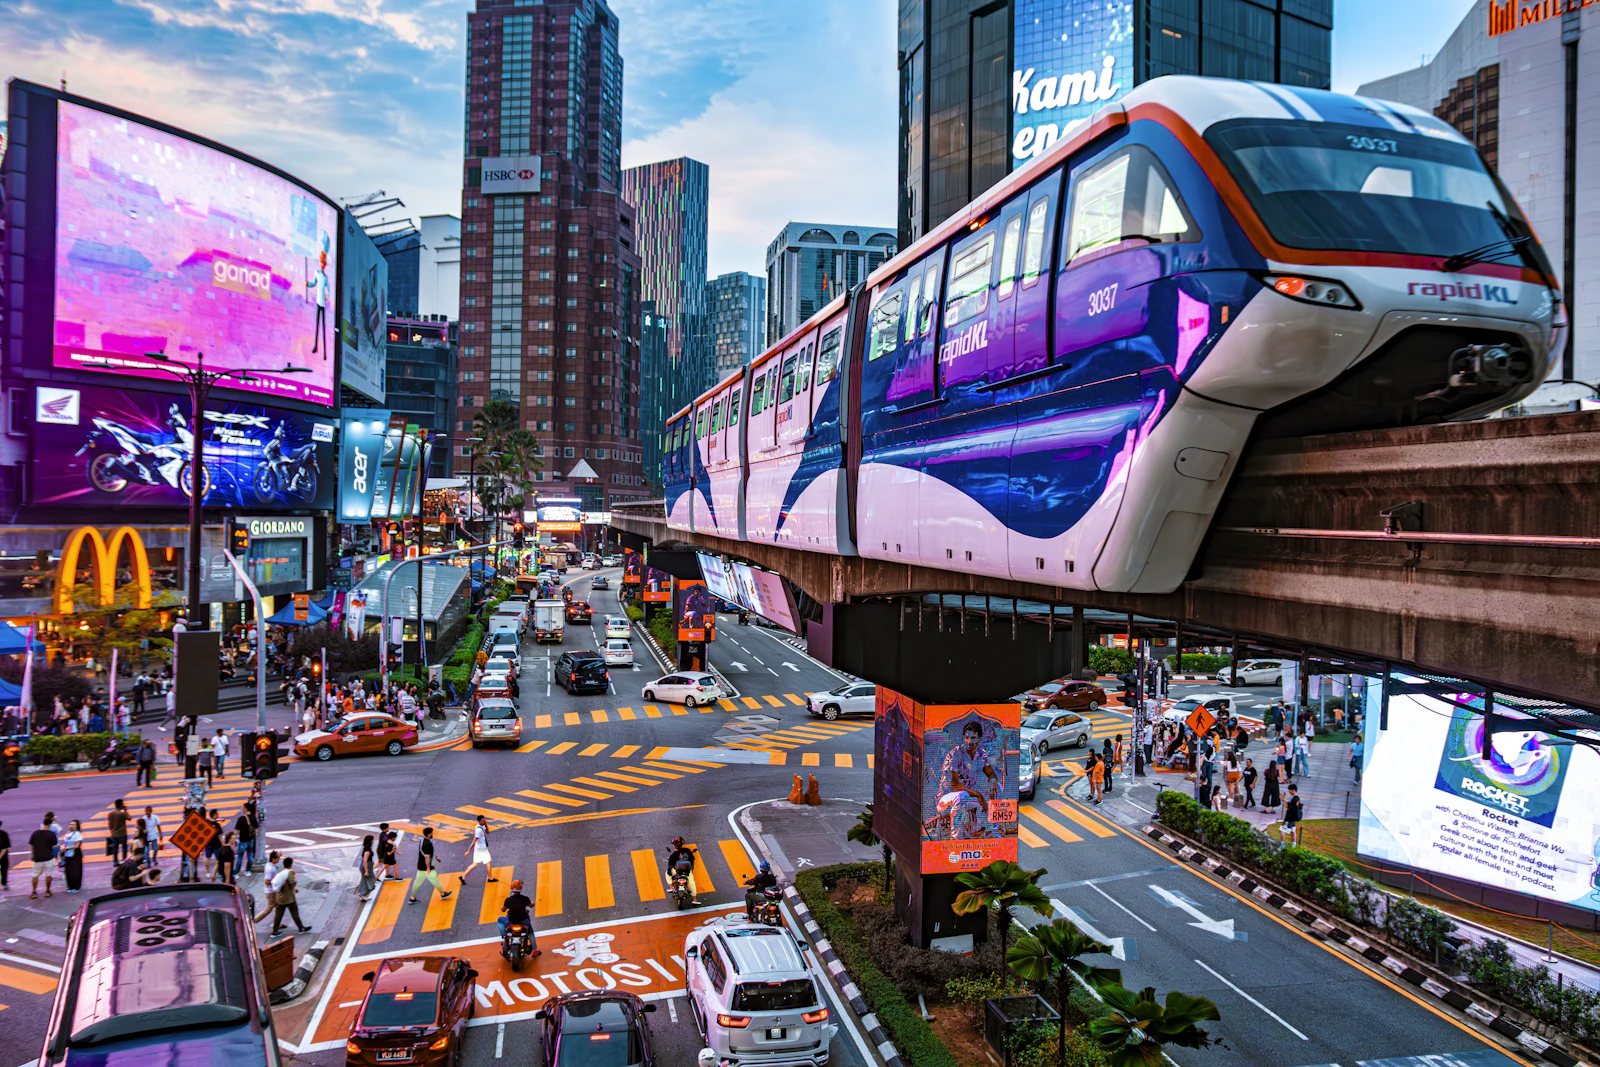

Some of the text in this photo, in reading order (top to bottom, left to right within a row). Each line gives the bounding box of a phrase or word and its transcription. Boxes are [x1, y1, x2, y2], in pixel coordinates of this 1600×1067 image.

[1013, 55, 1121, 114] Kami
[1346, 135, 1398, 152] 3037
[484, 170, 516, 181] HSBC
[213, 259, 272, 292] ganad
[1088, 283, 1119, 316] 3037
[1407, 281, 1518, 305] rapidKL
[938, 319, 988, 367] rapidKL
[353, 446, 368, 494] acer
[251, 519, 305, 536] GIORDANO
[1461, 777, 1530, 808] ROCKET
[992, 811, 1013, 821] RM59
[1435, 804, 1565, 855] with Christina Warren, Brianna Wu
[1482, 808, 1519, 828] Rocket
[961, 850, 991, 860] max
[1440, 824, 1557, 872] Geek out about tech and geek
[1461, 821, 1489, 837] Simone
[1490, 832, 1501, 842] de
[1502, 836, 1541, 856] Rochefort
[1432, 841, 1556, 892] popular all-female tech podcast.
[1440, 835, 1554, 881] culture with the first and most
